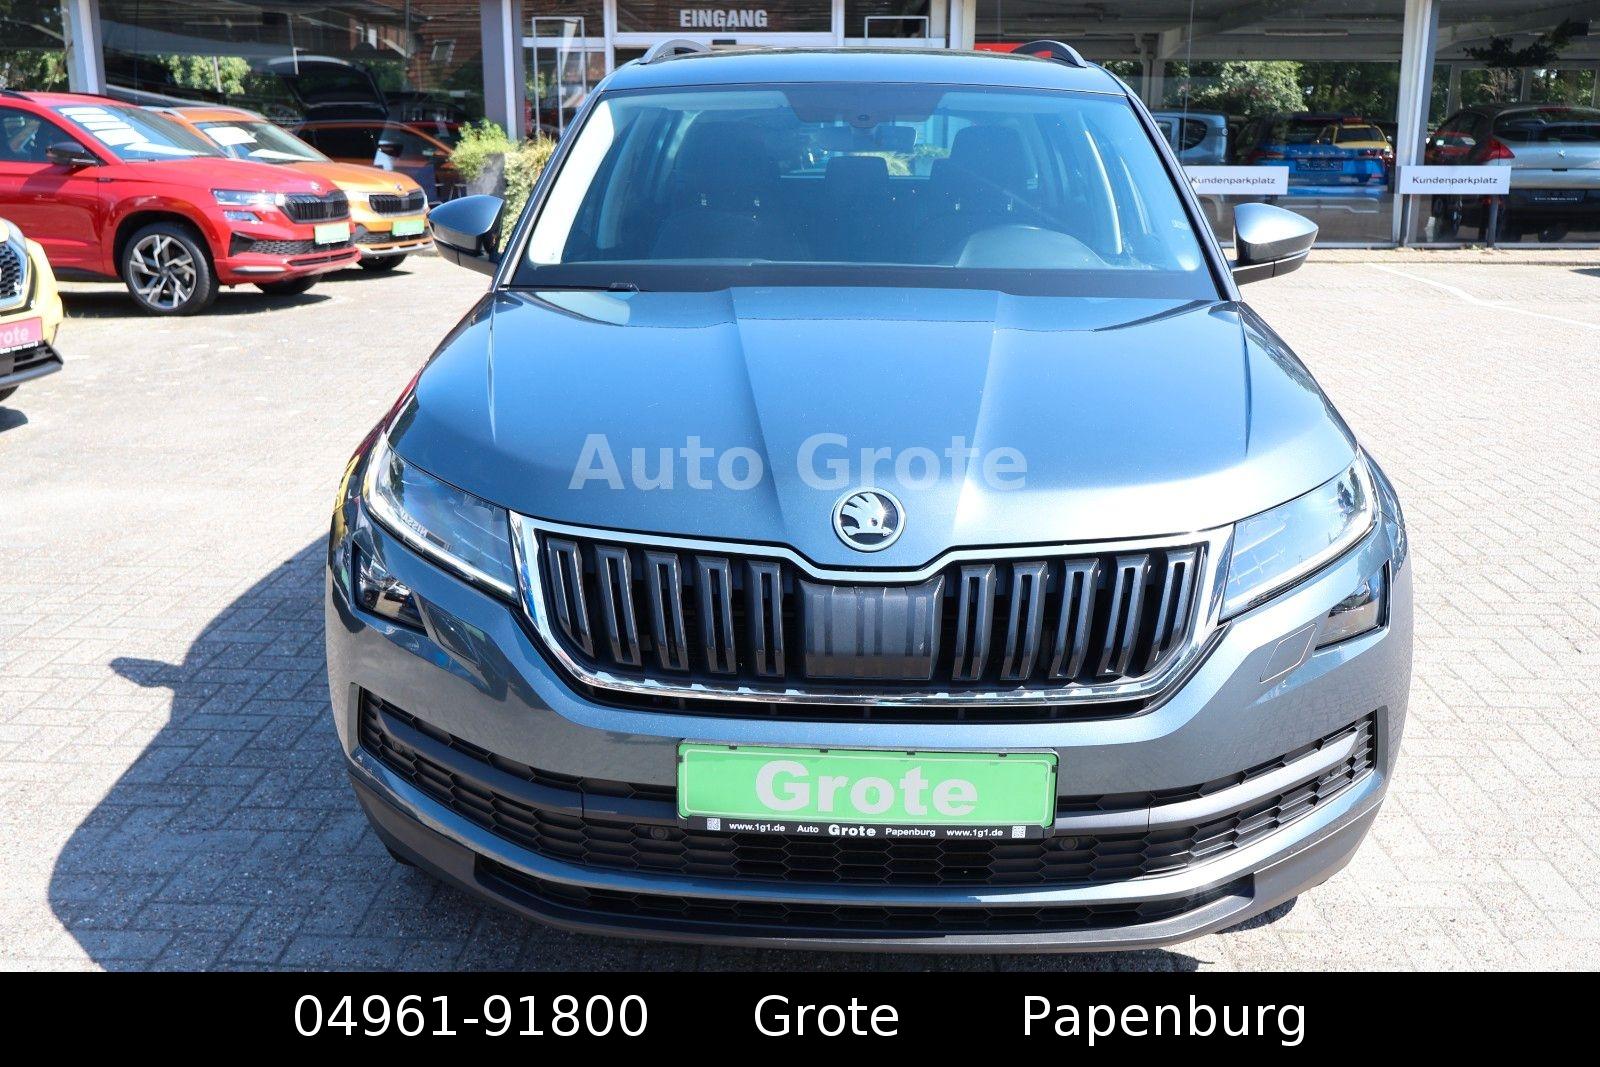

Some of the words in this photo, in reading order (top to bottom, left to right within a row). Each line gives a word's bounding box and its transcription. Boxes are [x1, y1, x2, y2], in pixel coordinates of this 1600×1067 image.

[680, 9, 768, 27] EINGANG
[1190, 176, 1276, 186] Kundenparkplatz
[1412, 176, 1498, 185] Kundenparkplatz
[755, 760, 978, 816] Grote
[729, 822, 786, 832] www.1g1.de
[797, 825, 819, 833] Auto
[828, 824, 876, 836] Grote
[885, 828, 936, 837] Papenburg
[946, 829, 1004, 837] www.1g1.de
